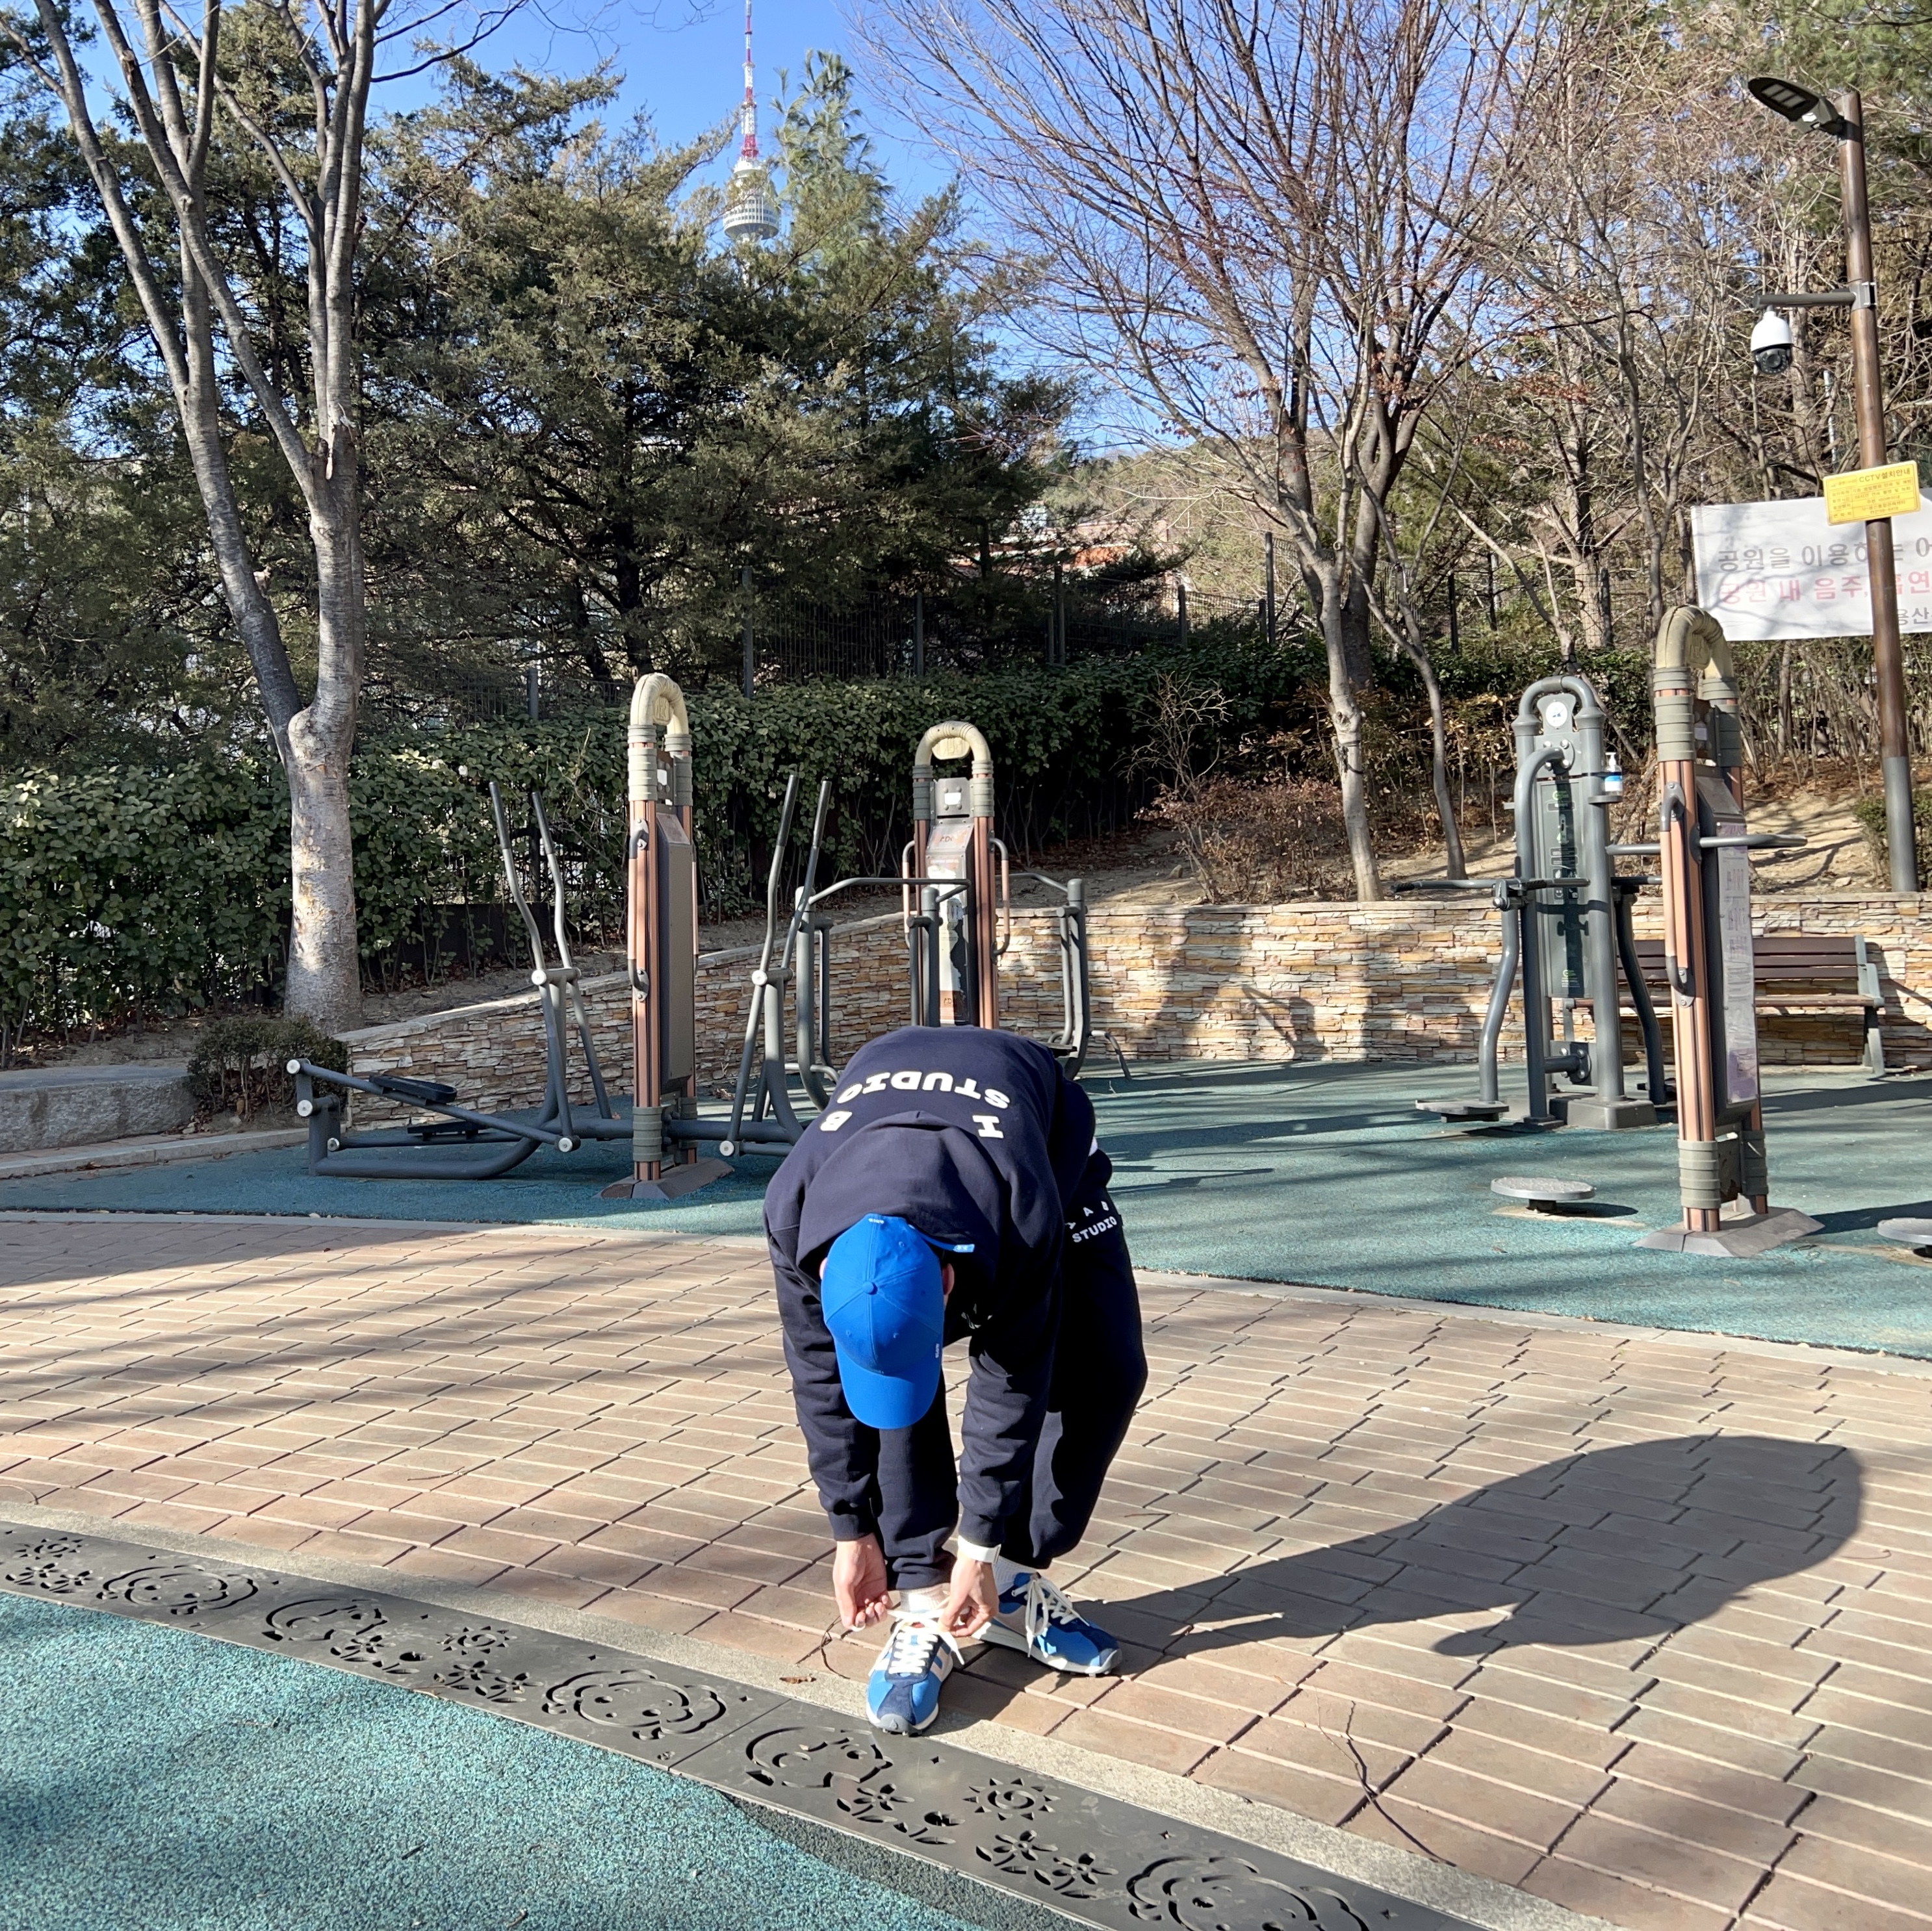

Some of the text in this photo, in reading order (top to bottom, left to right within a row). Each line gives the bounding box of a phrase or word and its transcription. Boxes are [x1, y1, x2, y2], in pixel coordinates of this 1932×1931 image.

[1859, 467, 1911, 483] CCTV설치안내
[1718, 547, 1790, 572] 공원을
[1721, 578, 1767, 605] 공원
[1779, 579, 1801, 602] 내
[837, 1070, 1011, 1110] STUDIO
[1072, 1216, 1118, 1243] STUDIO
